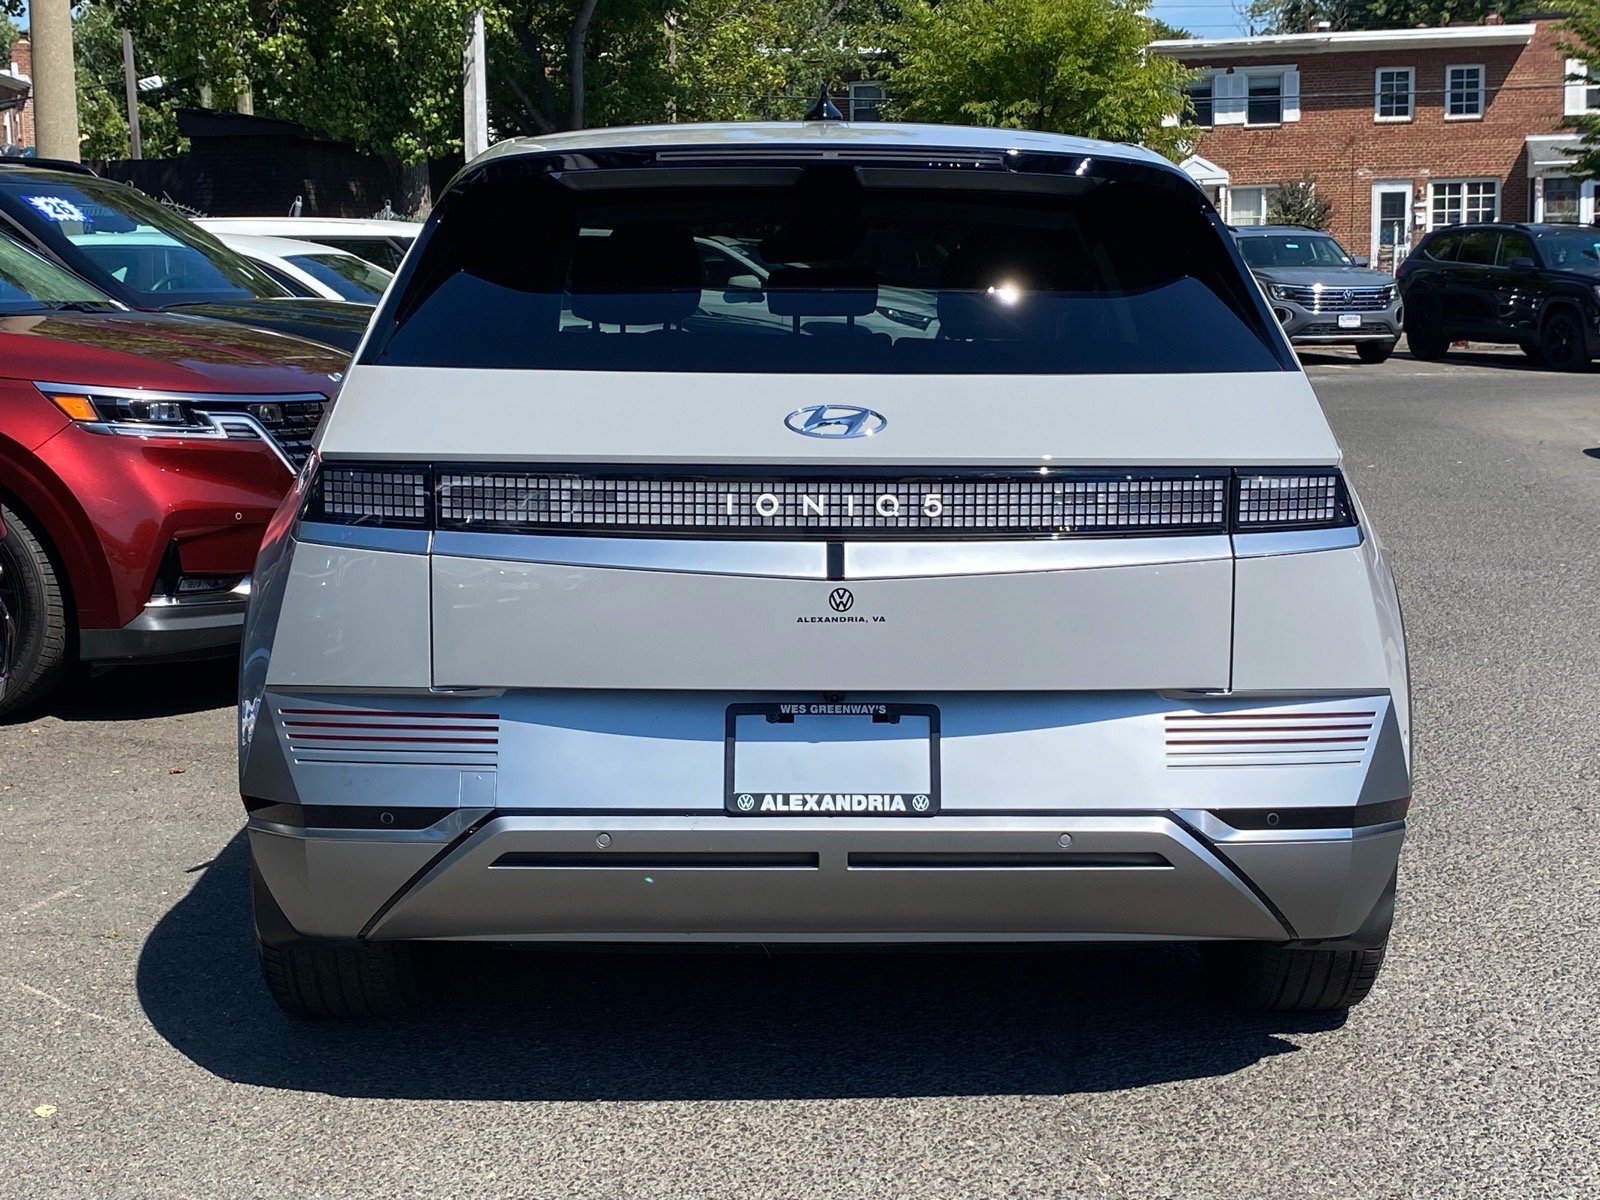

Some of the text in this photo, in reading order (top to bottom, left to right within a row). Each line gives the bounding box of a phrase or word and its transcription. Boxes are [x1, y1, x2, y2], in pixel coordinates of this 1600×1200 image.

[796, 616, 869, 624] ALEXANDRIA,
[780, 704, 887, 714] WES GREENWAY'S
[760, 794, 906, 811] ALEXANDRIA
